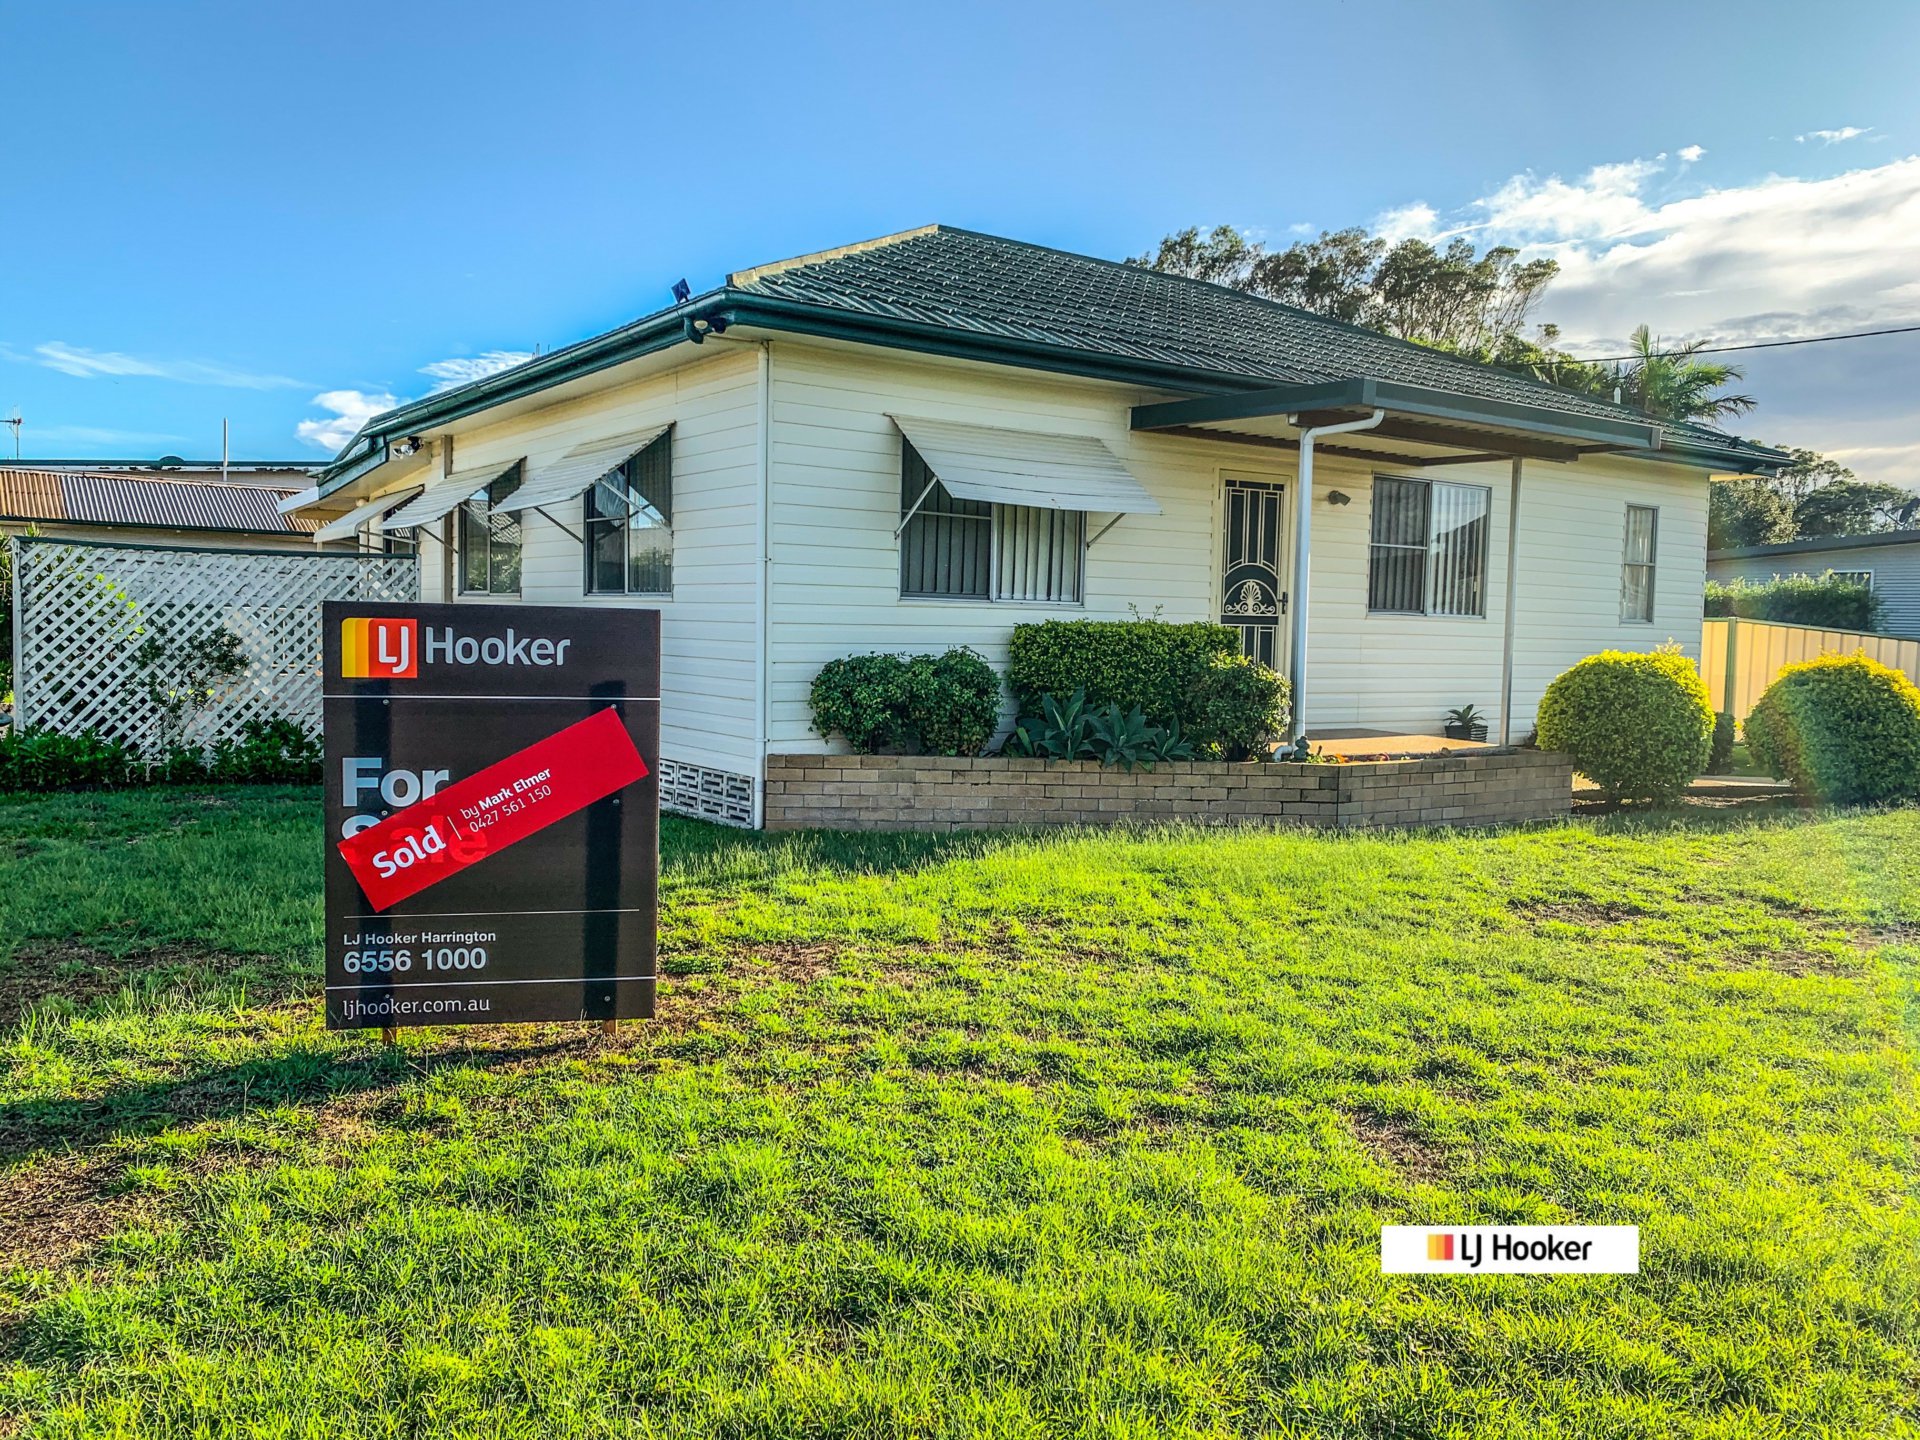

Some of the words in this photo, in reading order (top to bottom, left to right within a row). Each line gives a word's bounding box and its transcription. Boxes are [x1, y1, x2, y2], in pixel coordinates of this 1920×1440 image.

[378, 625, 409, 674] LJ
[425, 626, 571, 666] Hooker
[342, 757, 450, 807] For
[460, 805, 480, 820] by
[478, 788, 514, 811] Mark
[513, 768, 551, 793] Elmer
[469, 810, 500, 833] 0427
[501, 798, 526, 816] 561
[527, 784, 552, 804] 150
[372, 824, 447, 879] Sold
[343, 933, 360, 946] LJ
[364, 932, 418, 946] Hooker
[421, 930, 497, 947] Harrington
[343, 949, 412, 973] 6556
[421, 947, 487, 971] 1000
[342, 996, 491, 1020] ljhooker.com.au
